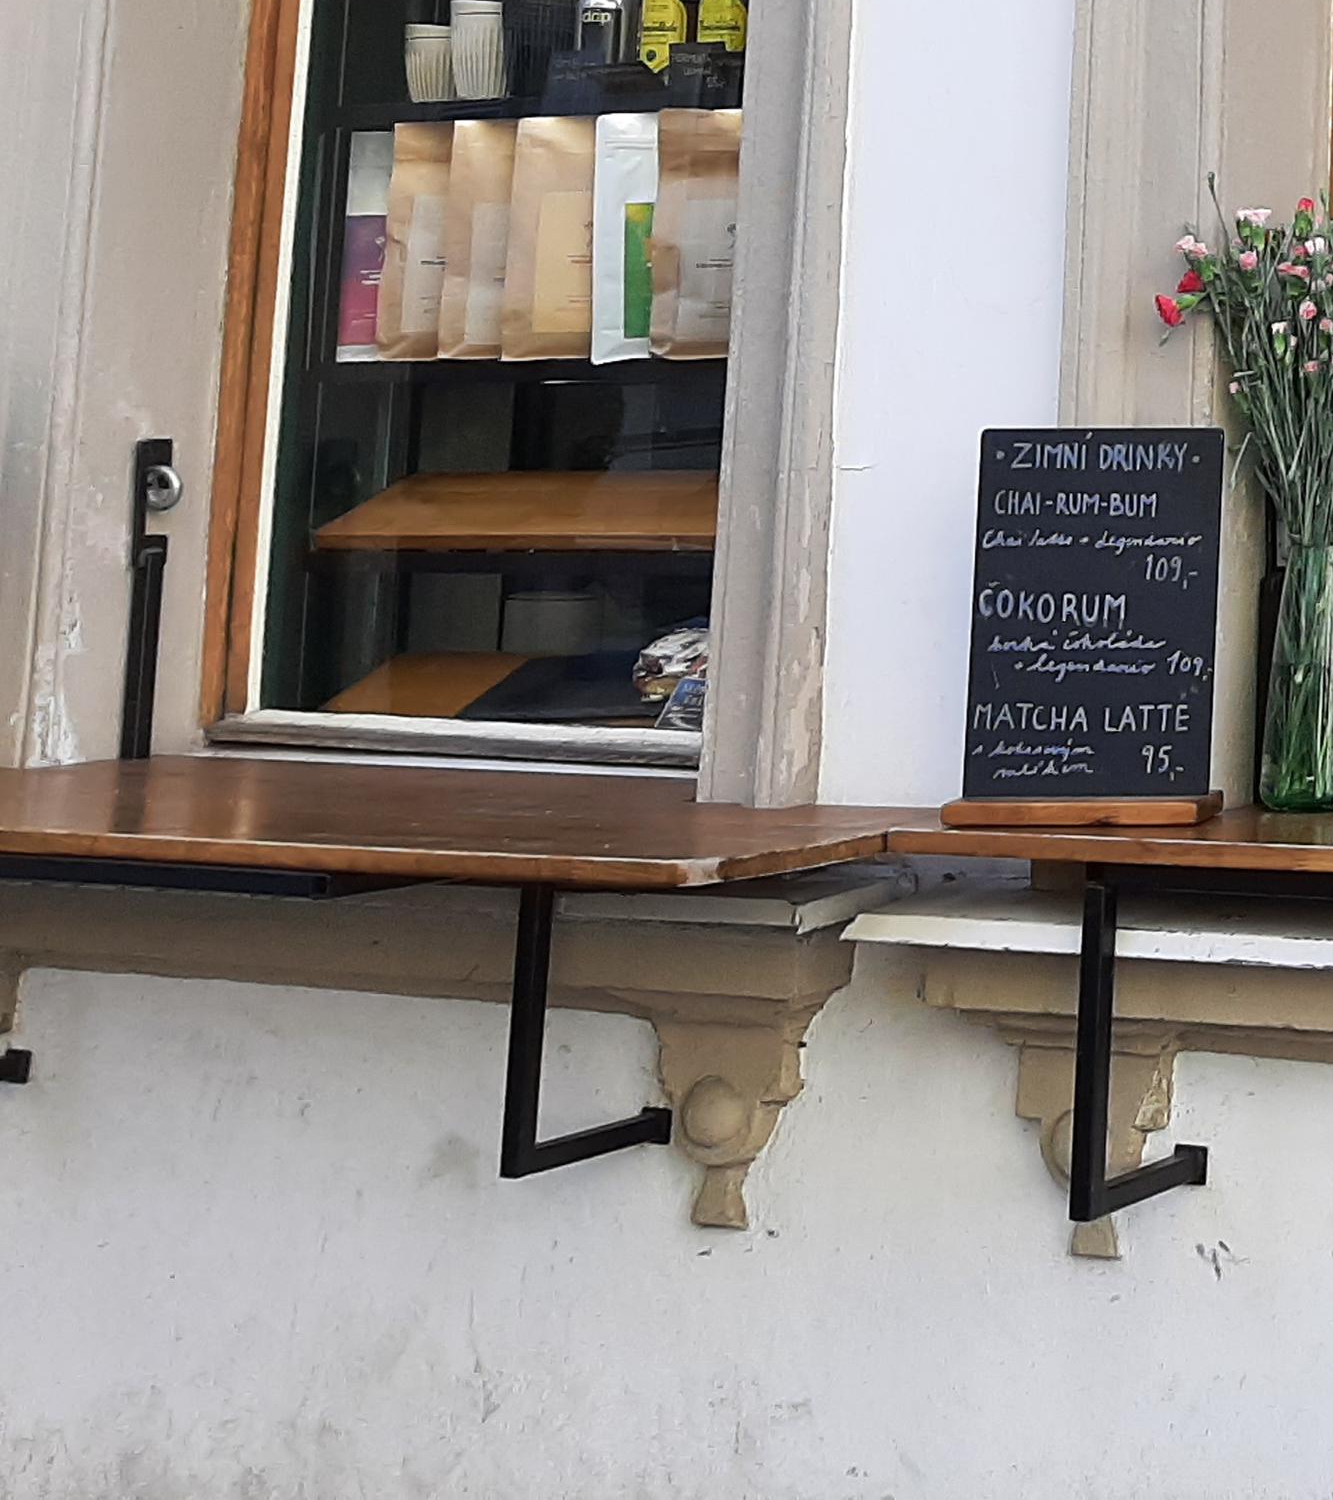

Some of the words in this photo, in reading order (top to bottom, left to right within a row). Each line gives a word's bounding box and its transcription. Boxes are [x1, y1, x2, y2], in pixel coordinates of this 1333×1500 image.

[1010, 431, 1093, 471] ZIMNÍ
[1099, 442, 1188, 472] DRINKY
[994, 489, 1157, 518] CHAI-RUM-BUM
[977, 580, 1127, 627] ČOKORUM
[973, 702, 1088, 733] MATCHA
[1104, 703, 1190, 732] LATTE
